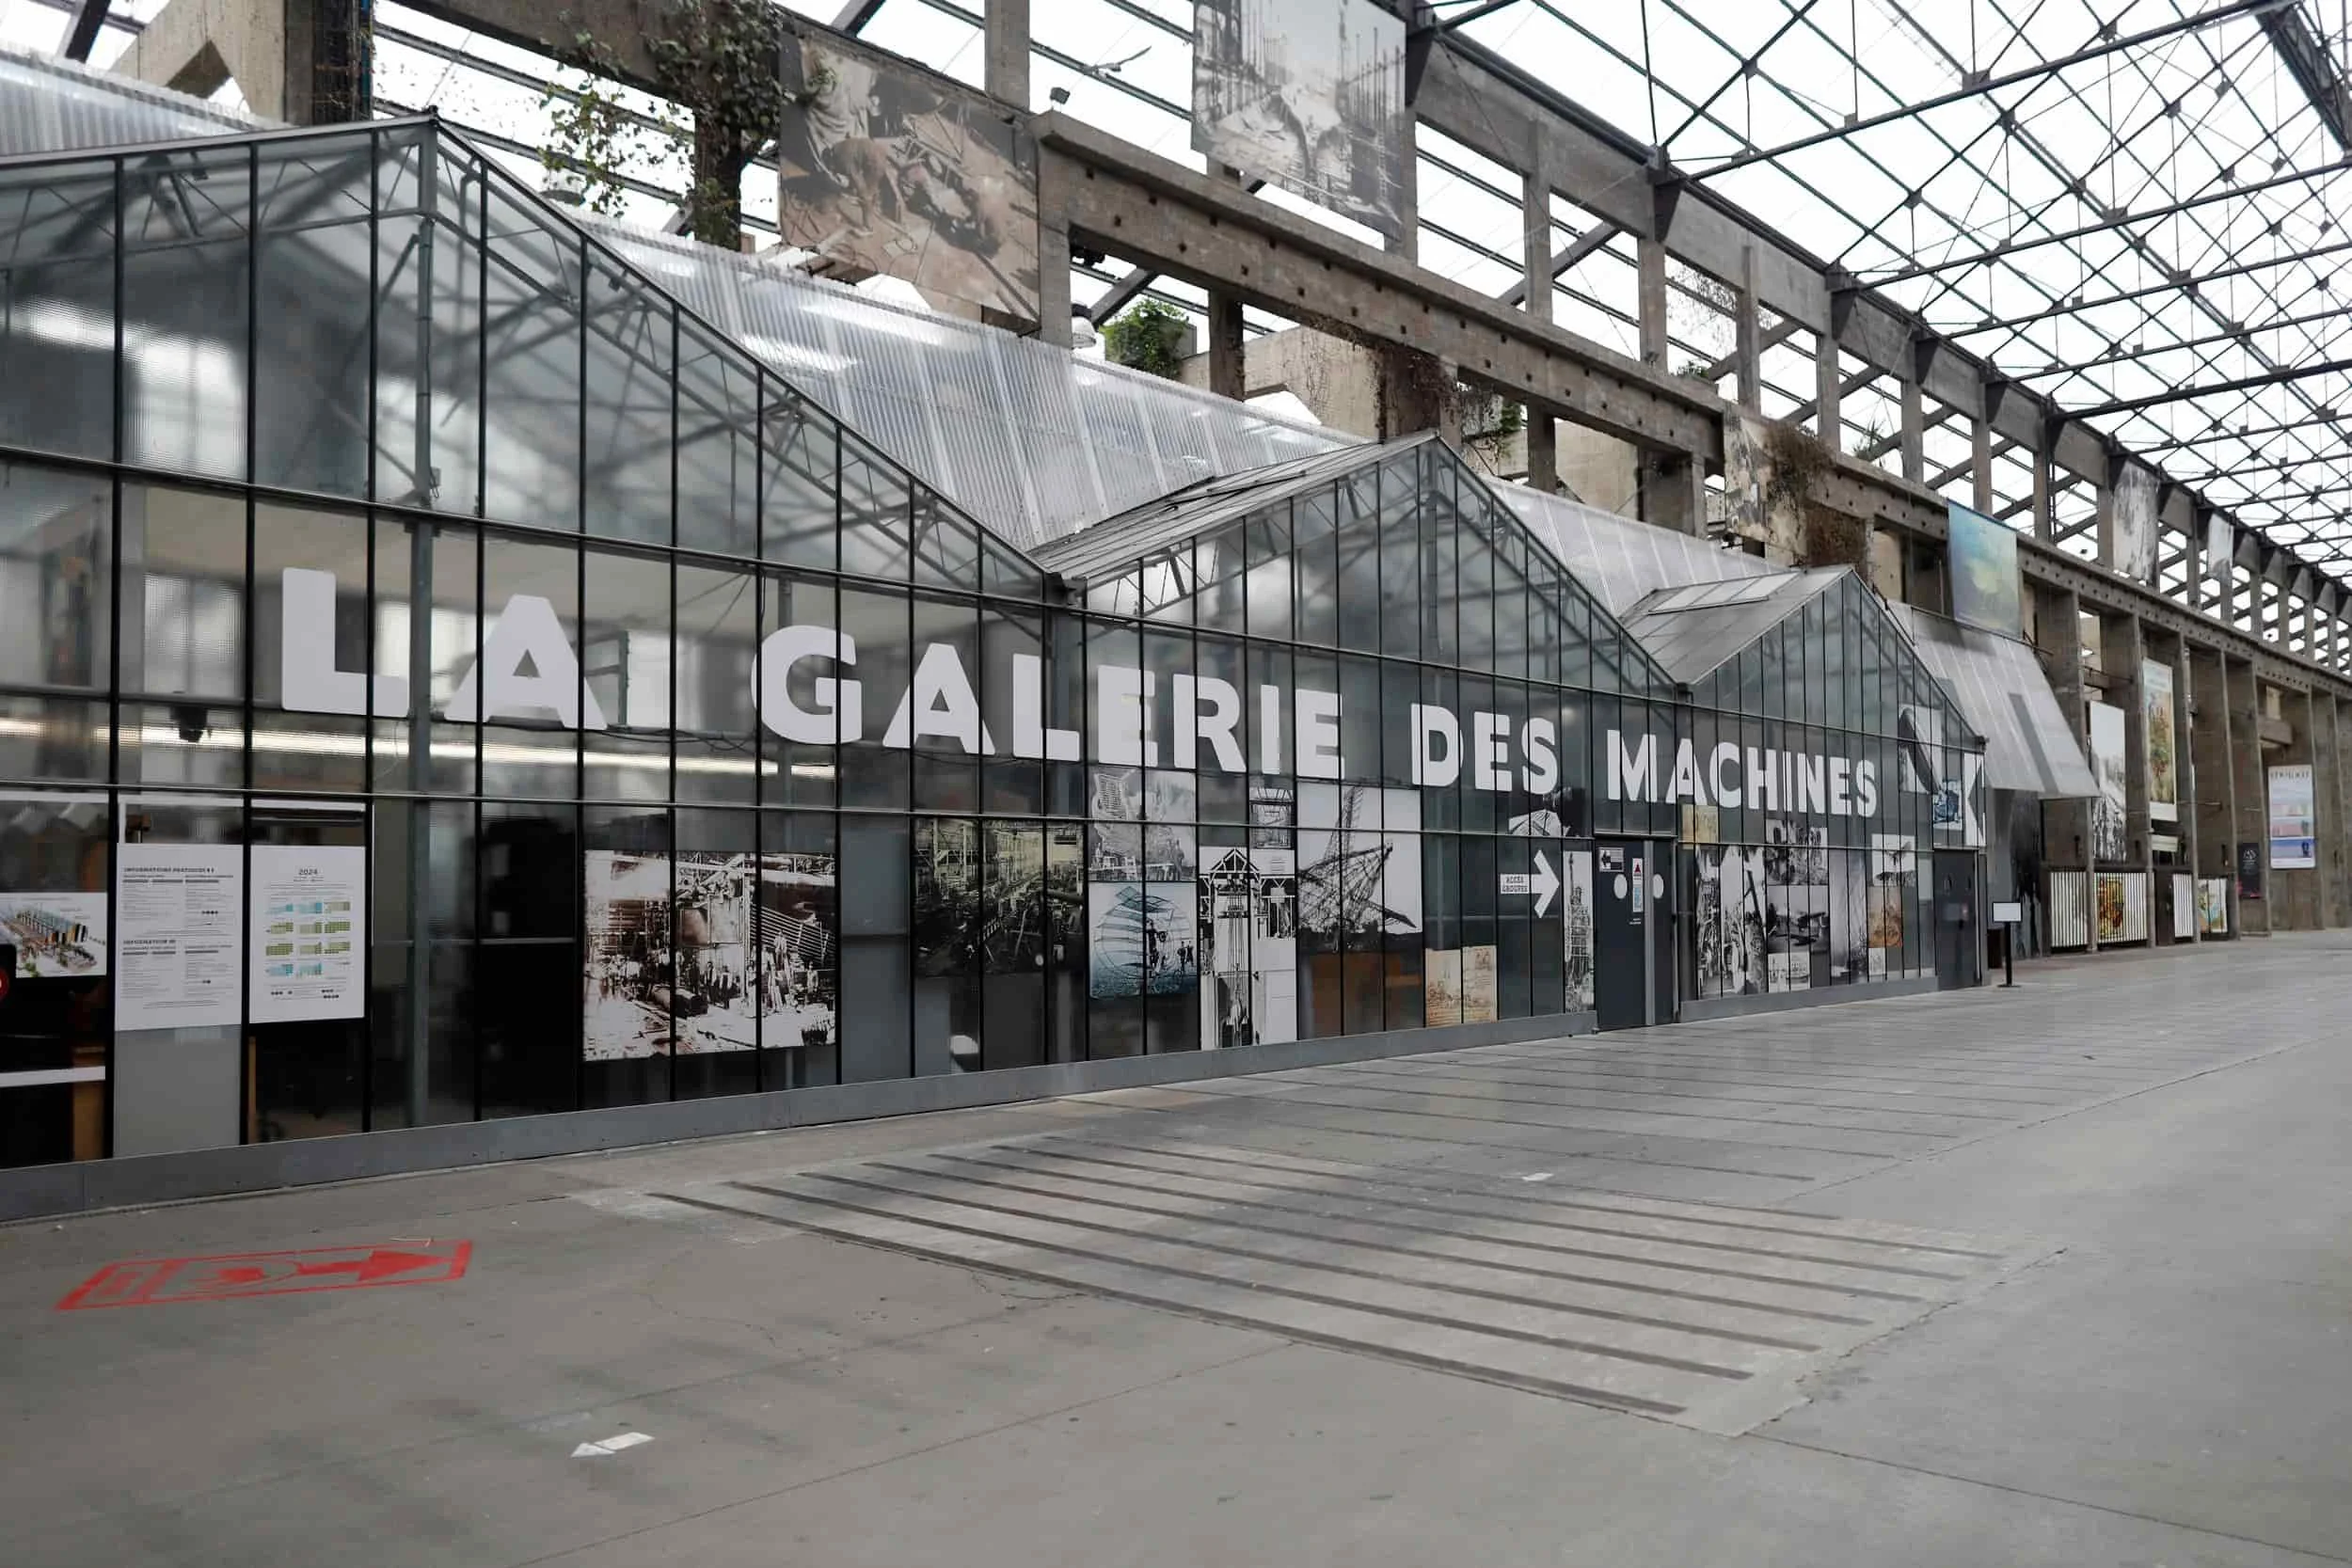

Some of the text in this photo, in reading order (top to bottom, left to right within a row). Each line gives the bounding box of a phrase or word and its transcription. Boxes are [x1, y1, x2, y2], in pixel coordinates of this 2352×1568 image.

[282, 568, 1878, 818] LA GALERIE DES MACHINES
